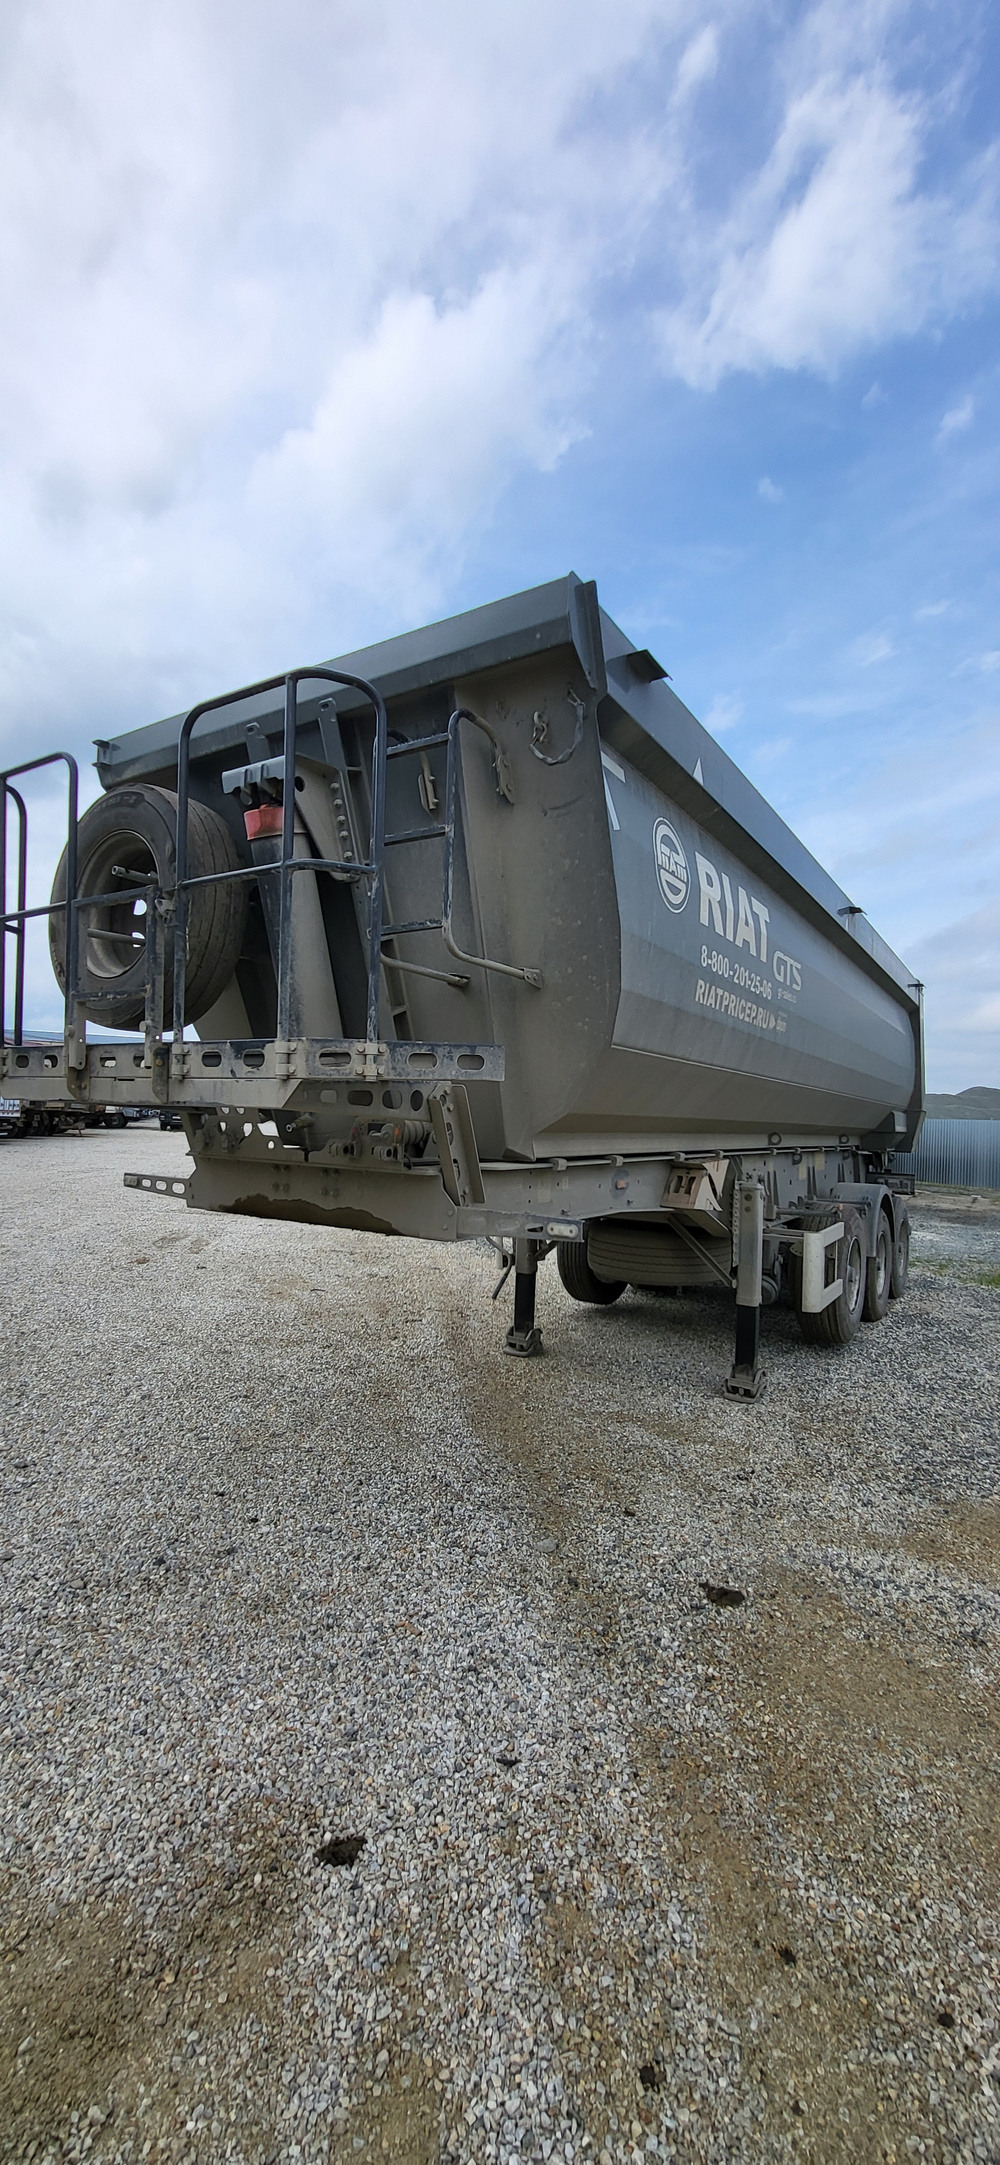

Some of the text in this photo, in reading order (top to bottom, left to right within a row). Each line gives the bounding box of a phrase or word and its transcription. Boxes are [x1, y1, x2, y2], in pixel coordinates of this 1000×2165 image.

[695, 851, 801, 991] RIAT GTS
[701, 945, 772, 1000] 8-800-201-25-06
[695, 979, 770, 1029] RIATPRICEP.RU
